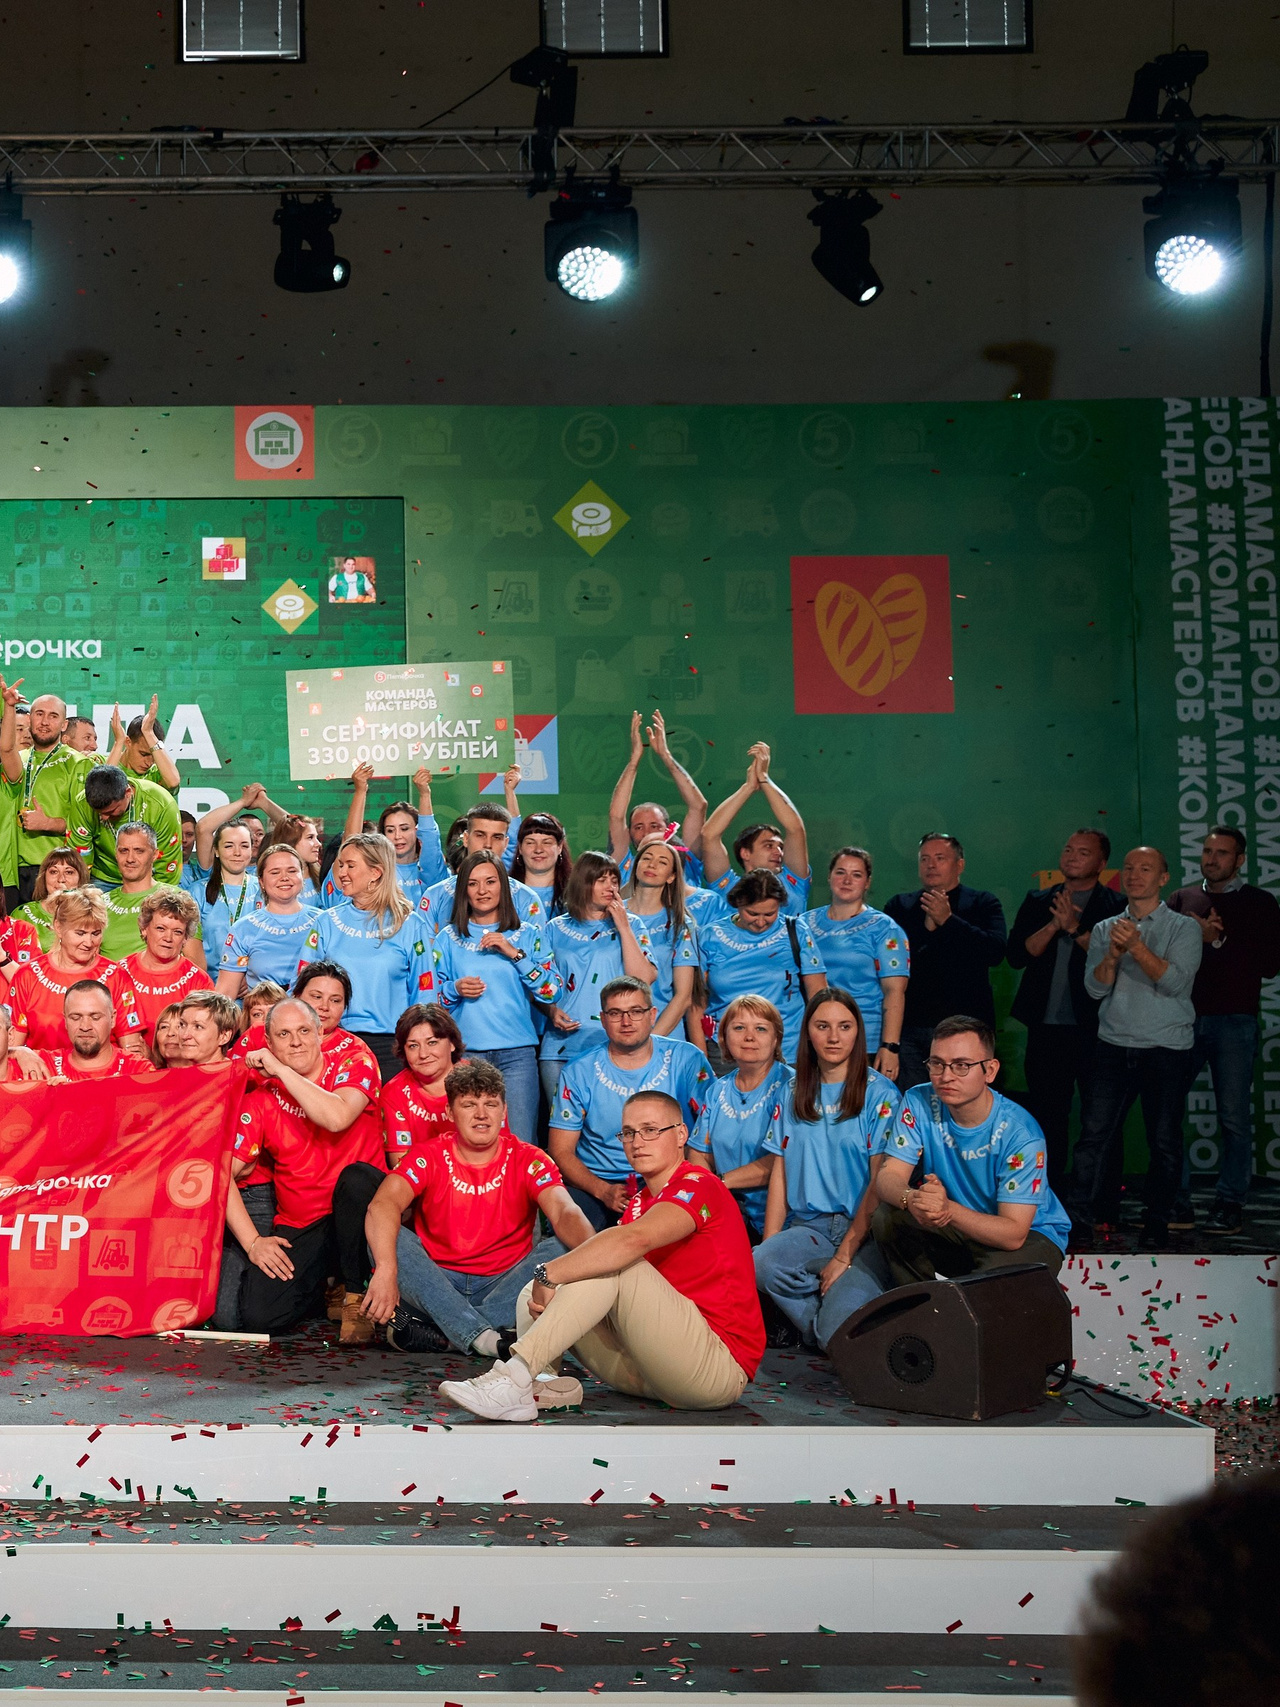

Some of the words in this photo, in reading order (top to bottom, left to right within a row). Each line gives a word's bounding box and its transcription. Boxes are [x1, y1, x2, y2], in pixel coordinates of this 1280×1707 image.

[365, 699, 437, 712] МАСТЕРОВ
[366, 688, 435, 701] КОМАНДА
[322, 720, 481, 743] СЕРТИФИКАТ
[308, 747, 350, 765] 330
[357, 744, 400, 763] 000
[408, 736, 498, 761] РУБЛЕЙ
[30, 961, 68, 995] КОМАНДА
